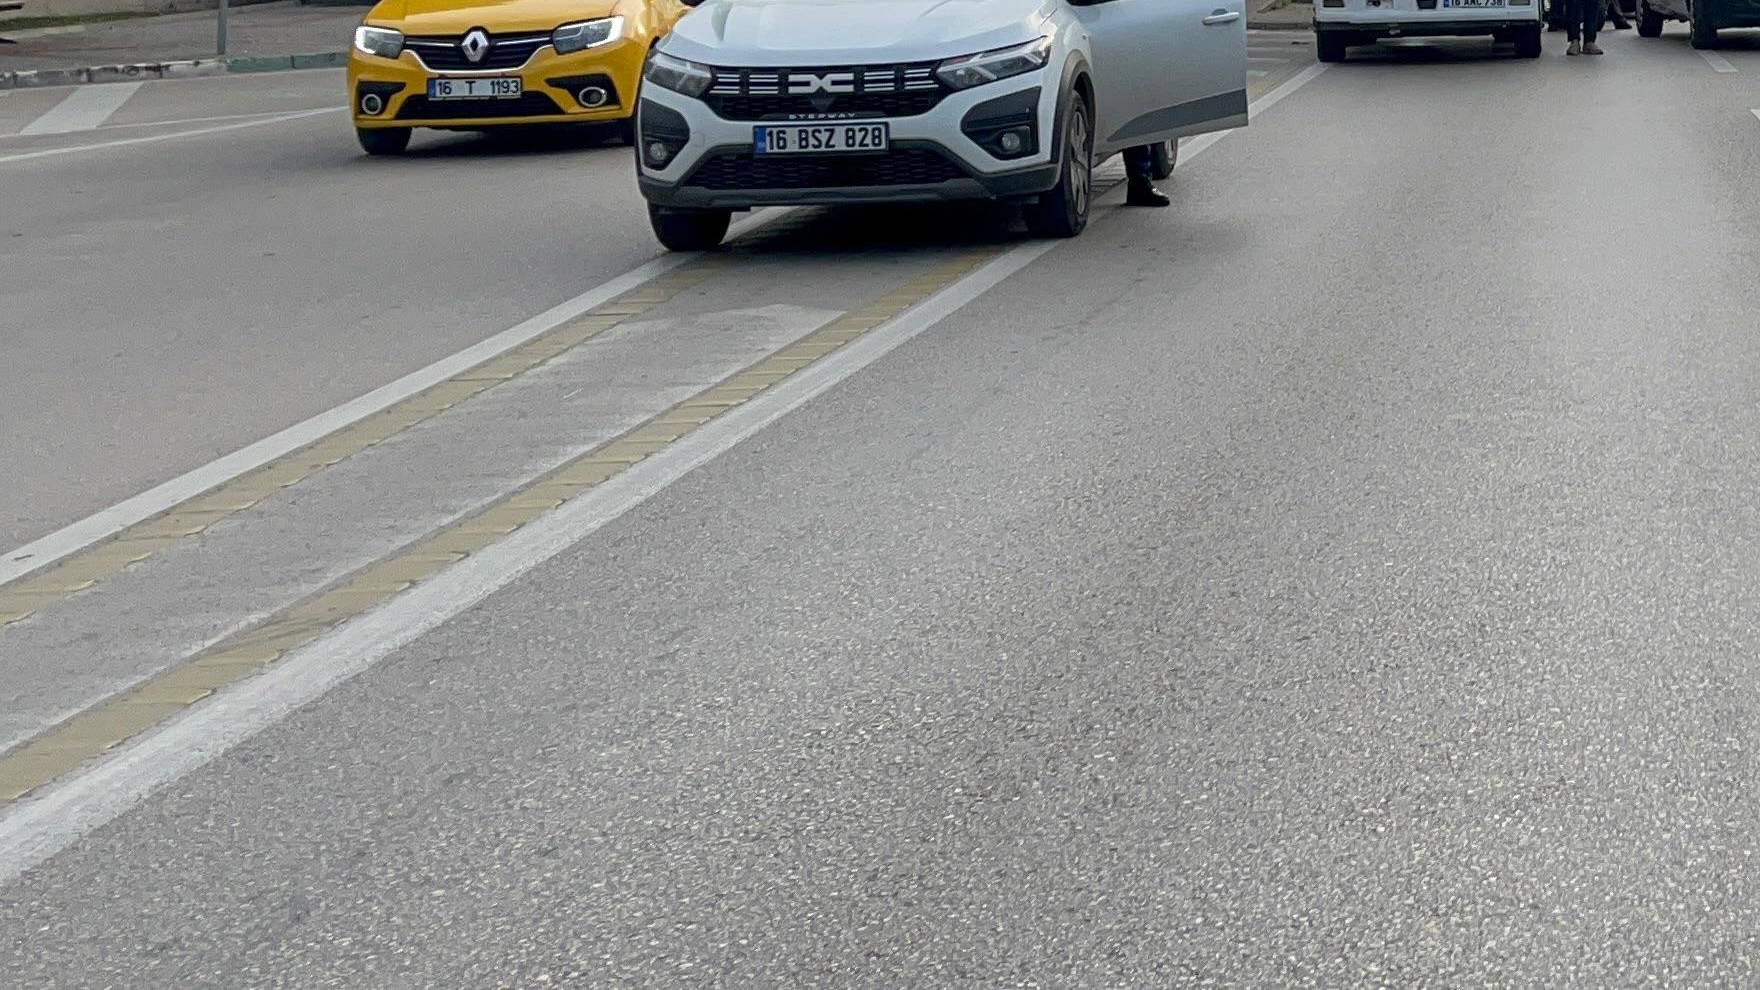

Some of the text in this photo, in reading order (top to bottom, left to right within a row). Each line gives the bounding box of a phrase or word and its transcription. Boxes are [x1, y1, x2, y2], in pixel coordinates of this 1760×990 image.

[438, 80, 519, 95] 16 T 1193
[767, 127, 882, 150] 16 BSZ 828
